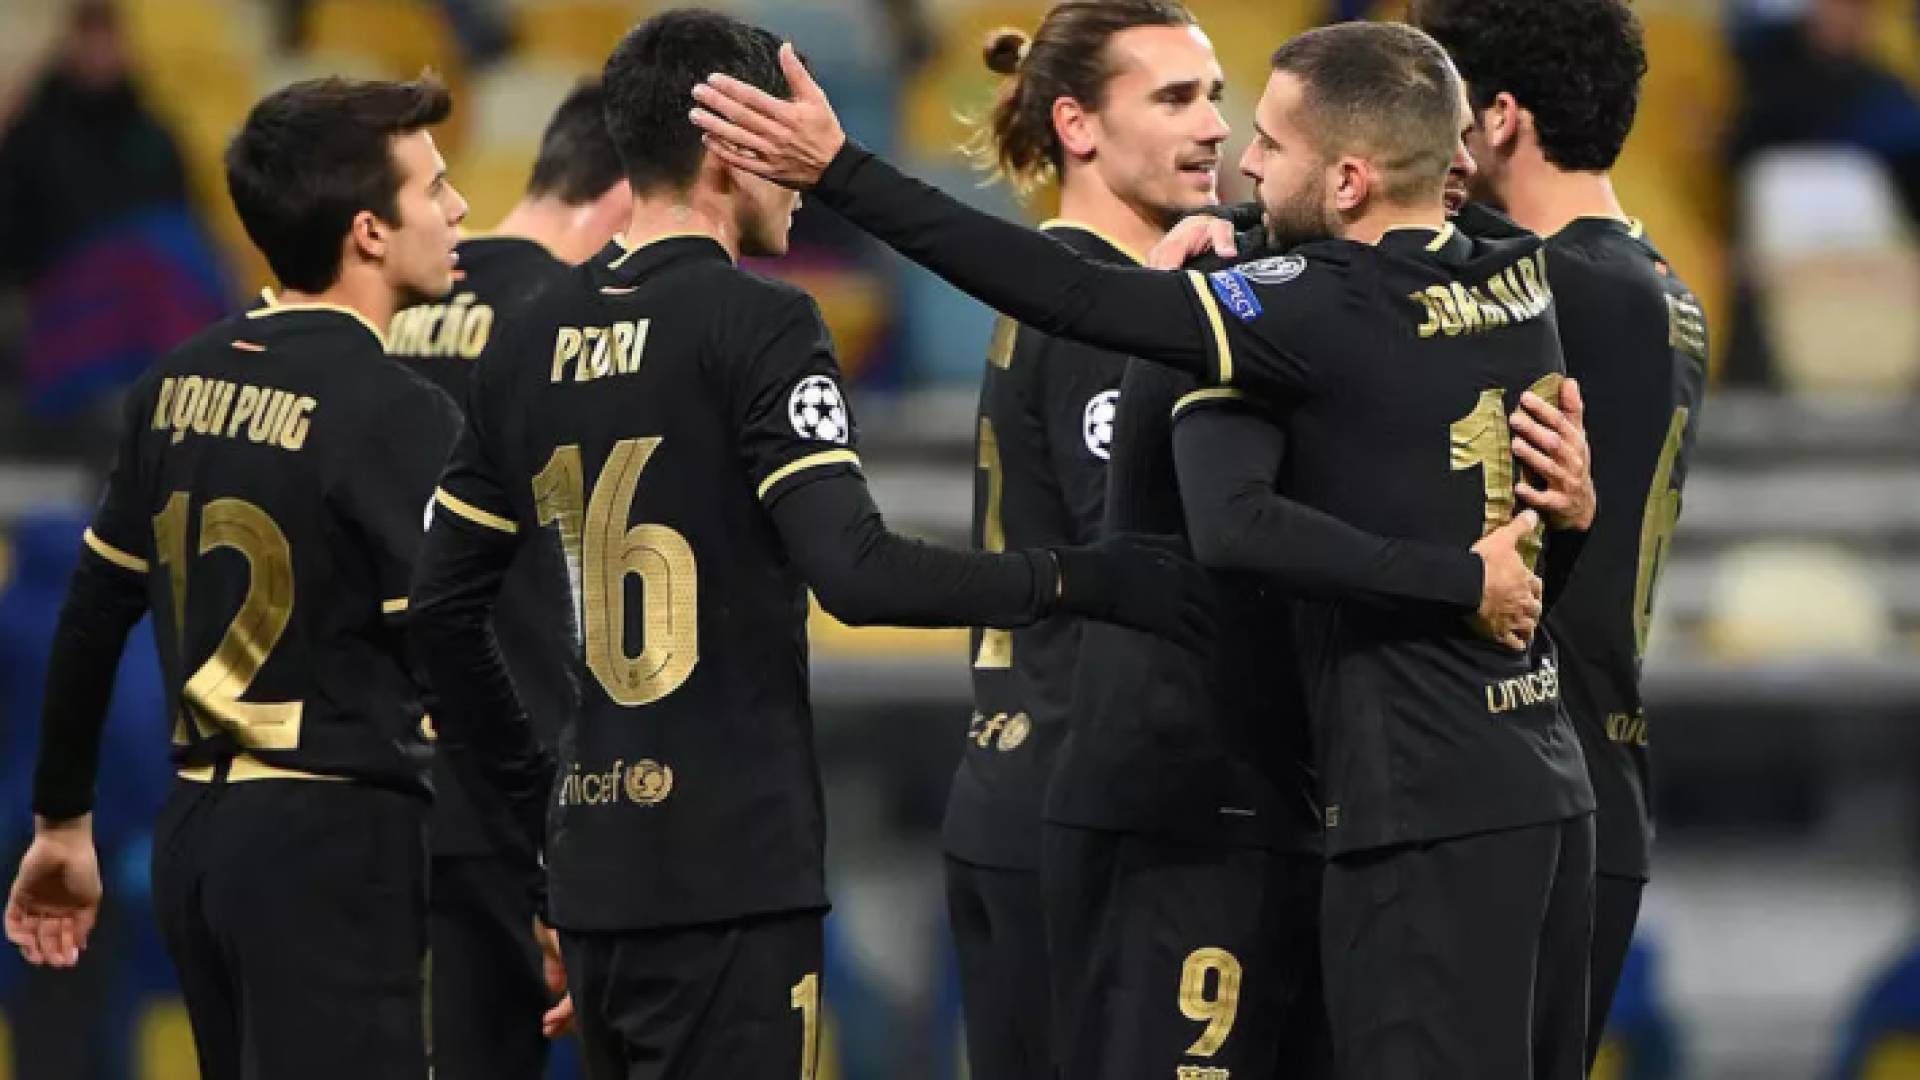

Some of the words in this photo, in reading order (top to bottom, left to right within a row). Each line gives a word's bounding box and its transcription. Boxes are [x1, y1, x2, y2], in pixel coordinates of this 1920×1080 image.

[226, 385, 317, 451] PUIG
[152, 491, 303, 750] 12
[532, 436, 699, 706] 16
[559, 758, 624, 806] nicef
[1179, 947, 1242, 1057] 9
